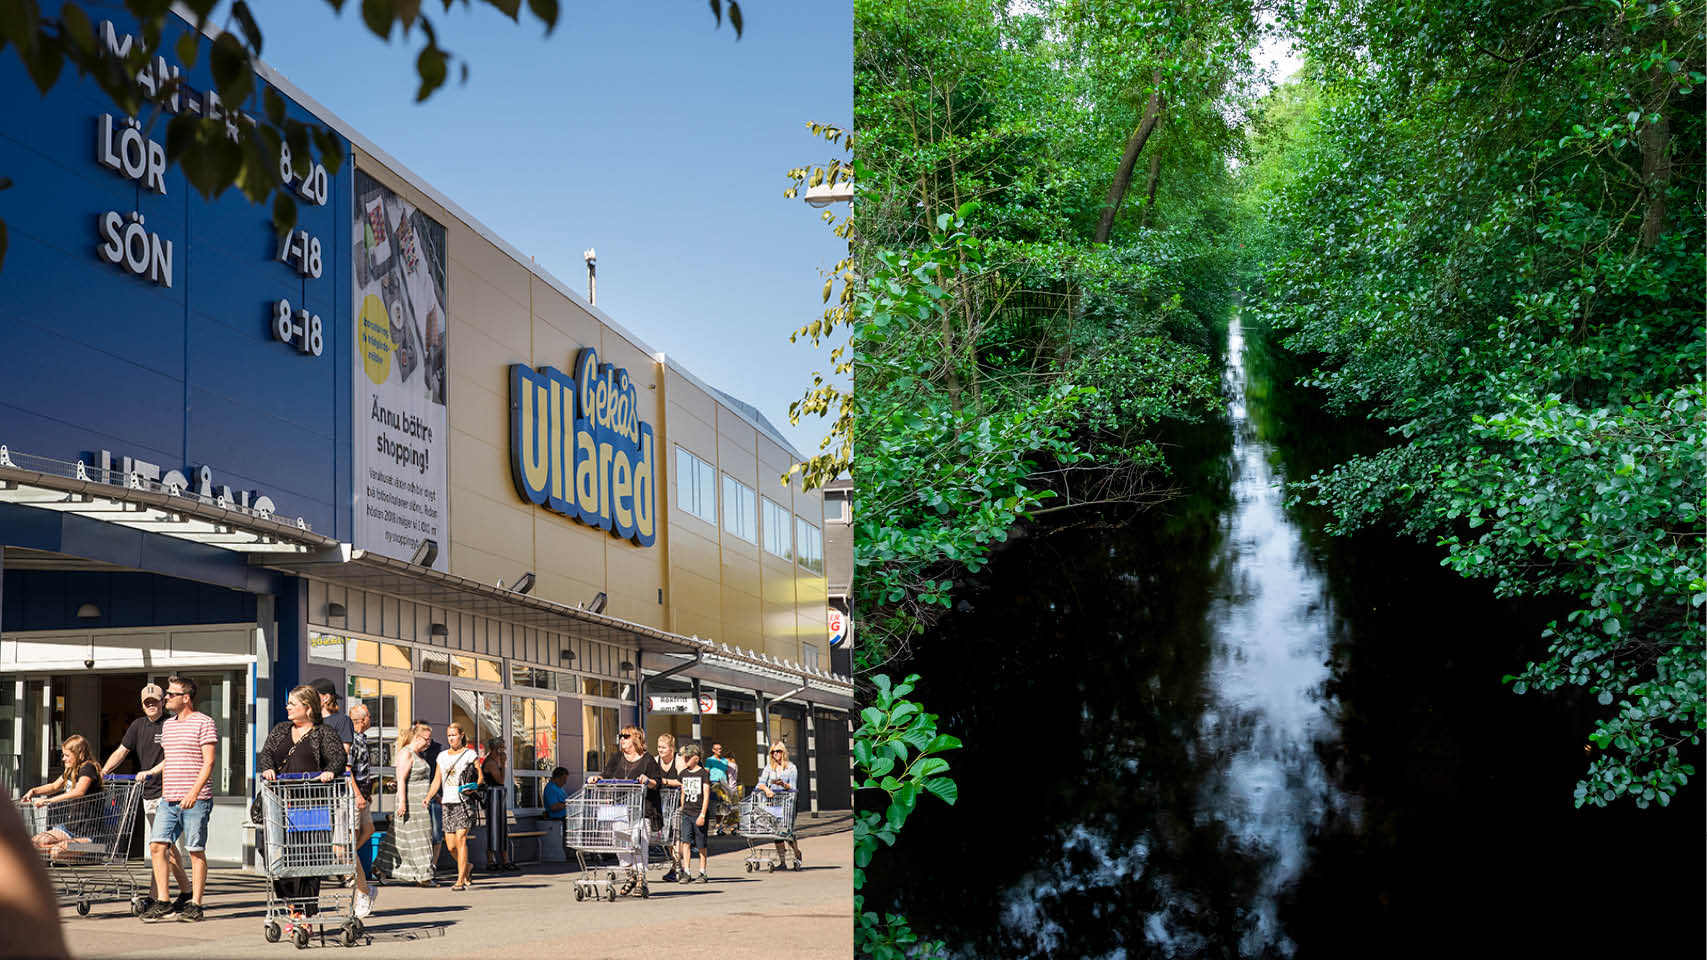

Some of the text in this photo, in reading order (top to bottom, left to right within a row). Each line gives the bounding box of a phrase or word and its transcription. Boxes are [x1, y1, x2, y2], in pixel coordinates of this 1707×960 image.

[102, 113, 168, 196] LÖR
[102, 211, 173, 288] SÖN
[278, 298, 324, 357] 8-18
[371, 393, 433, 443] Ännu bättre
[582, 353, 639, 444] Gekås
[377, 432, 429, 475] shopping!
[521, 376, 654, 537] Ullared
